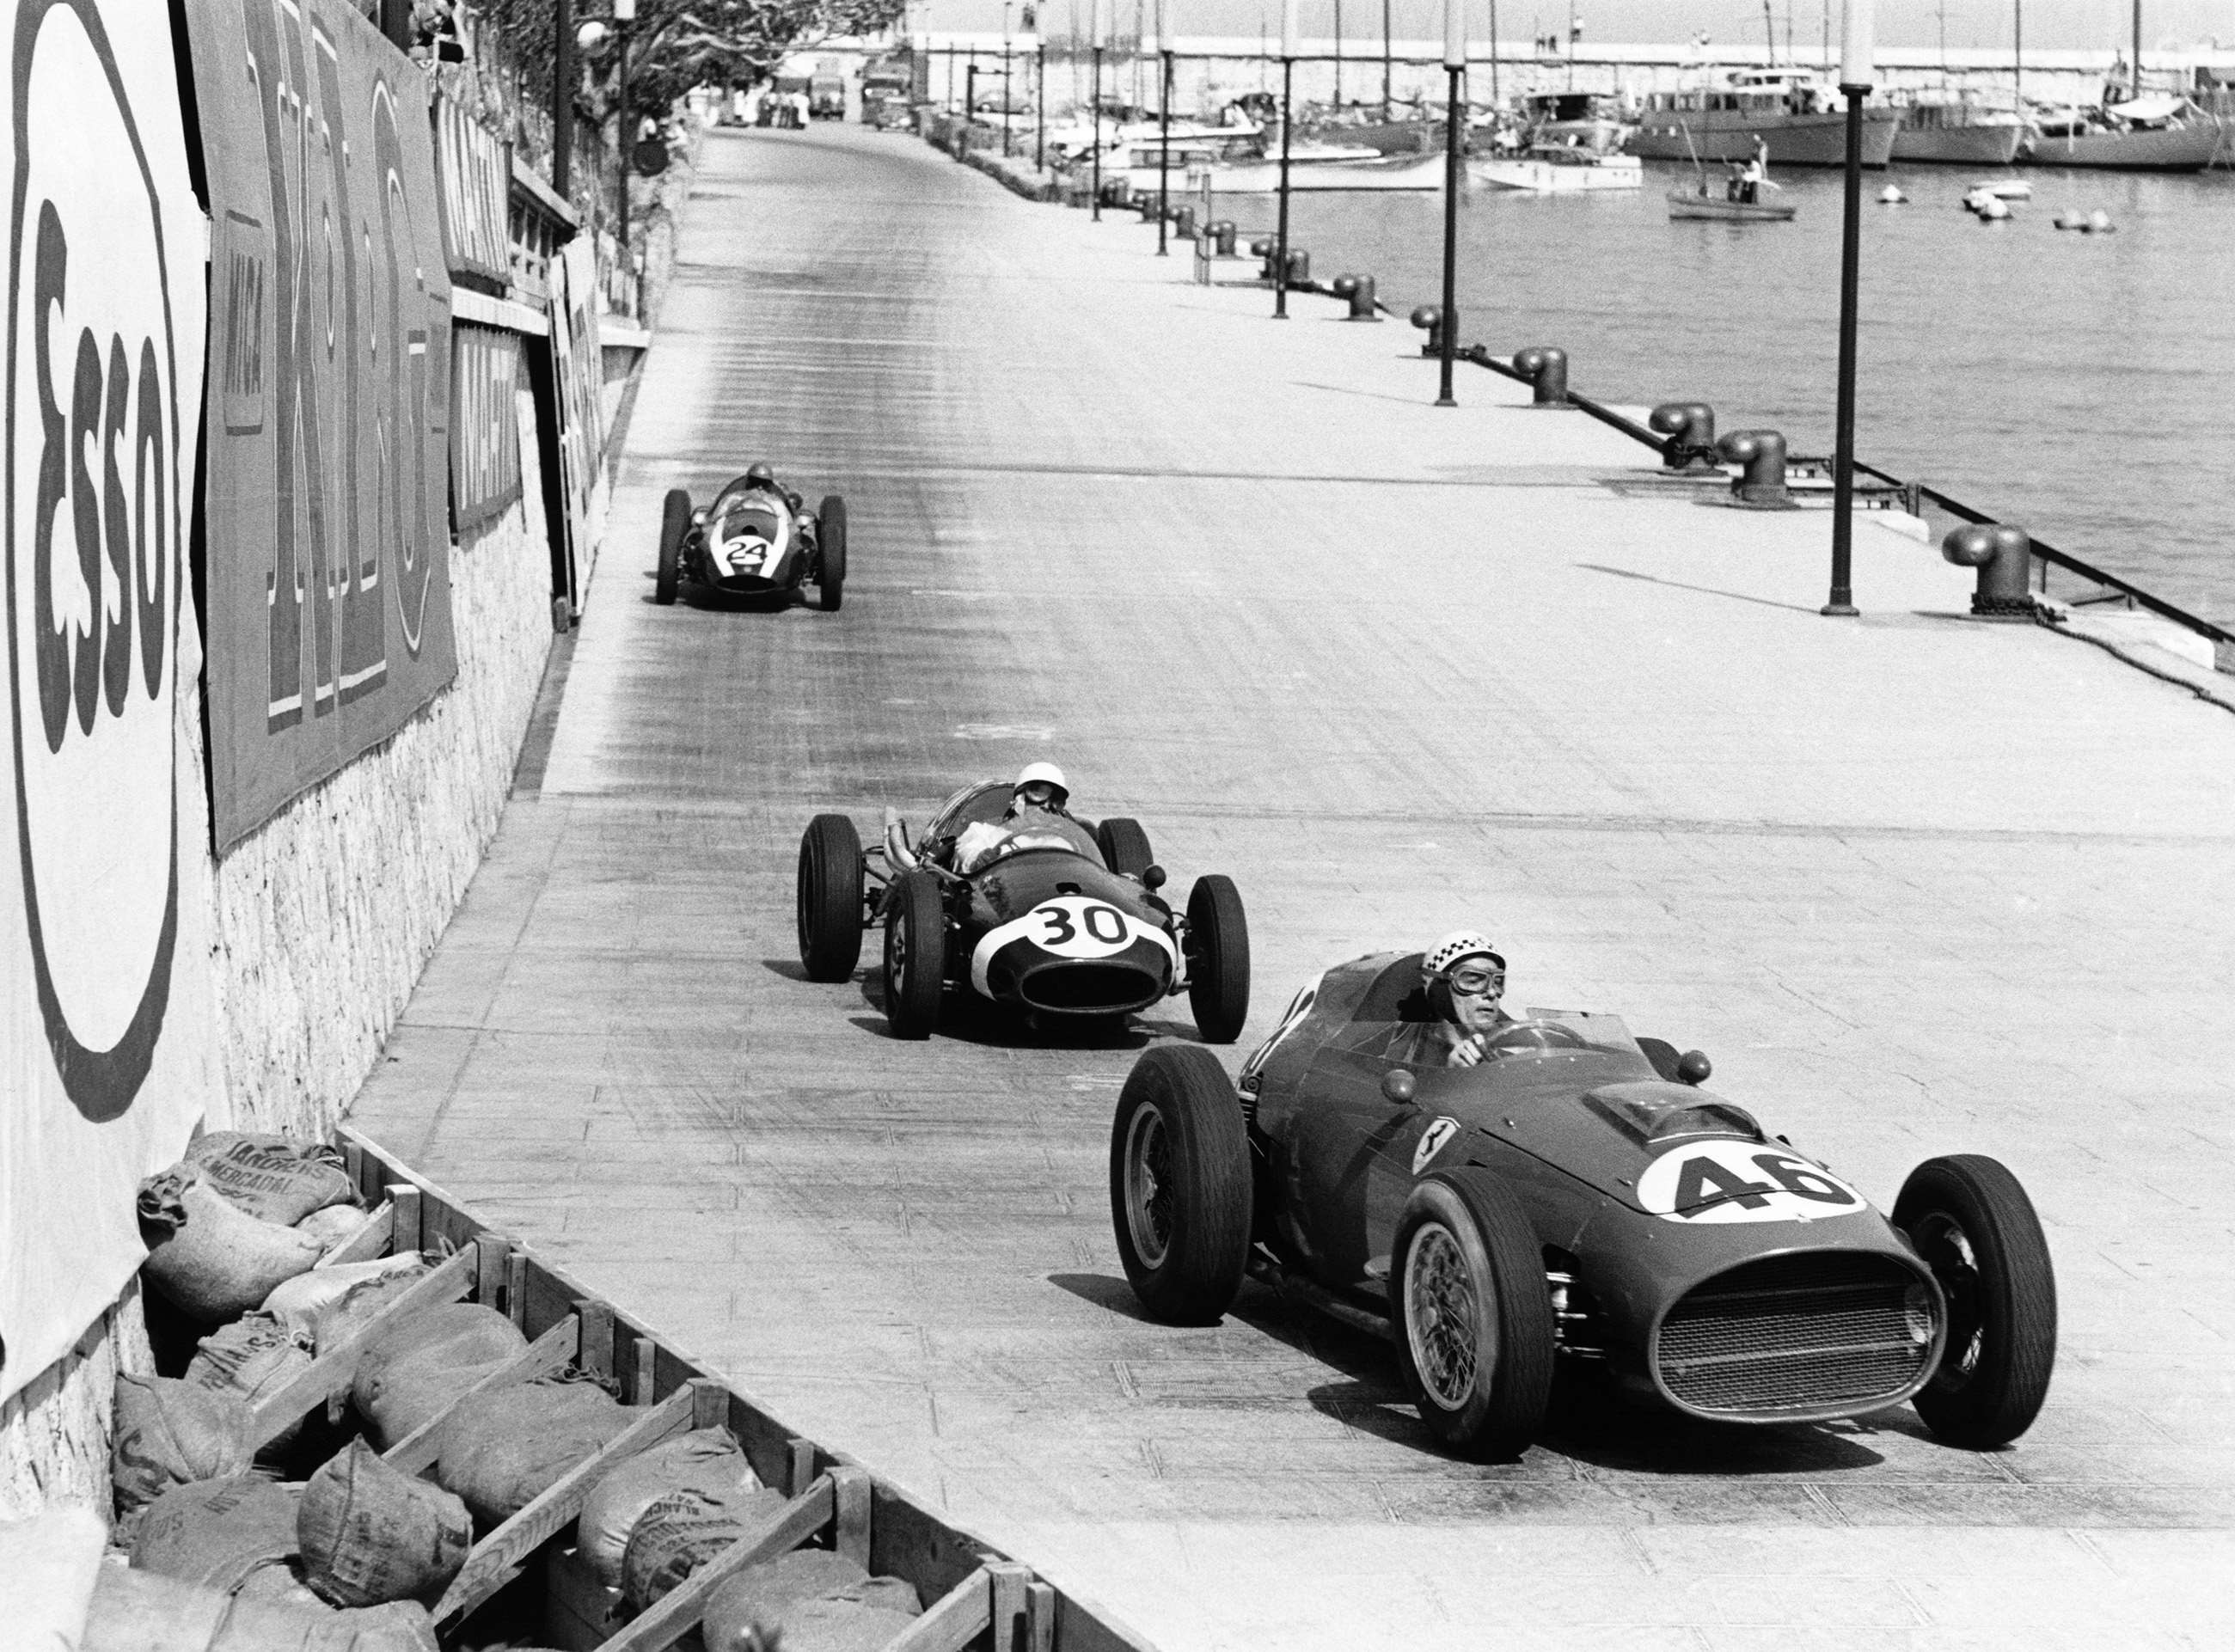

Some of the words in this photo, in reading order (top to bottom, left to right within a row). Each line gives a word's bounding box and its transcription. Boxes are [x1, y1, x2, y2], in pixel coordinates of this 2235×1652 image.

[34, 198, 165, 755] Esso
[726, 541, 768, 562] 24
[1033, 904, 1128, 945] 30
[1674, 1153, 1855, 1220] 46
